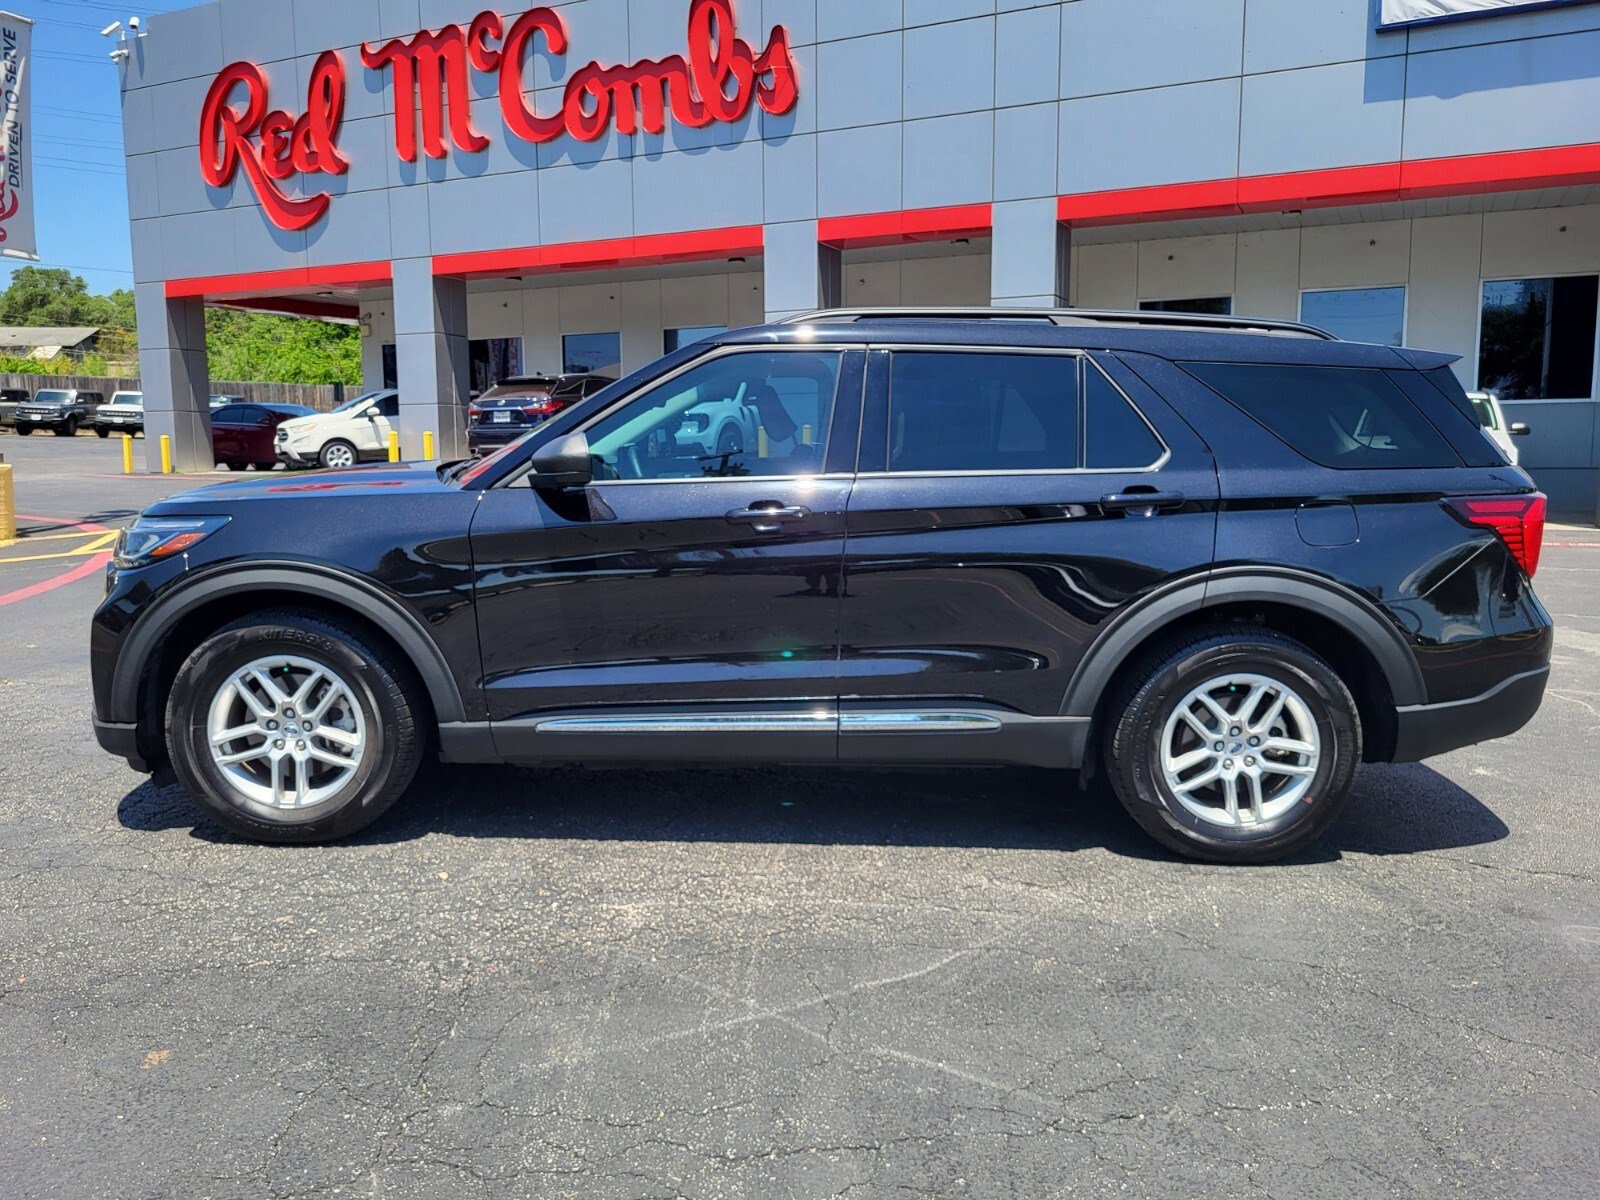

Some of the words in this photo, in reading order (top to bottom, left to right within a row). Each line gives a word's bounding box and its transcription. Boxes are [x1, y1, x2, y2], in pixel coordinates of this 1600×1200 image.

[3, 27, 17, 86] SERVE
[5, 89, 19, 113] TO
[8, 120, 20, 188] DRIVEN
[200, 49, 350, 231] Red
